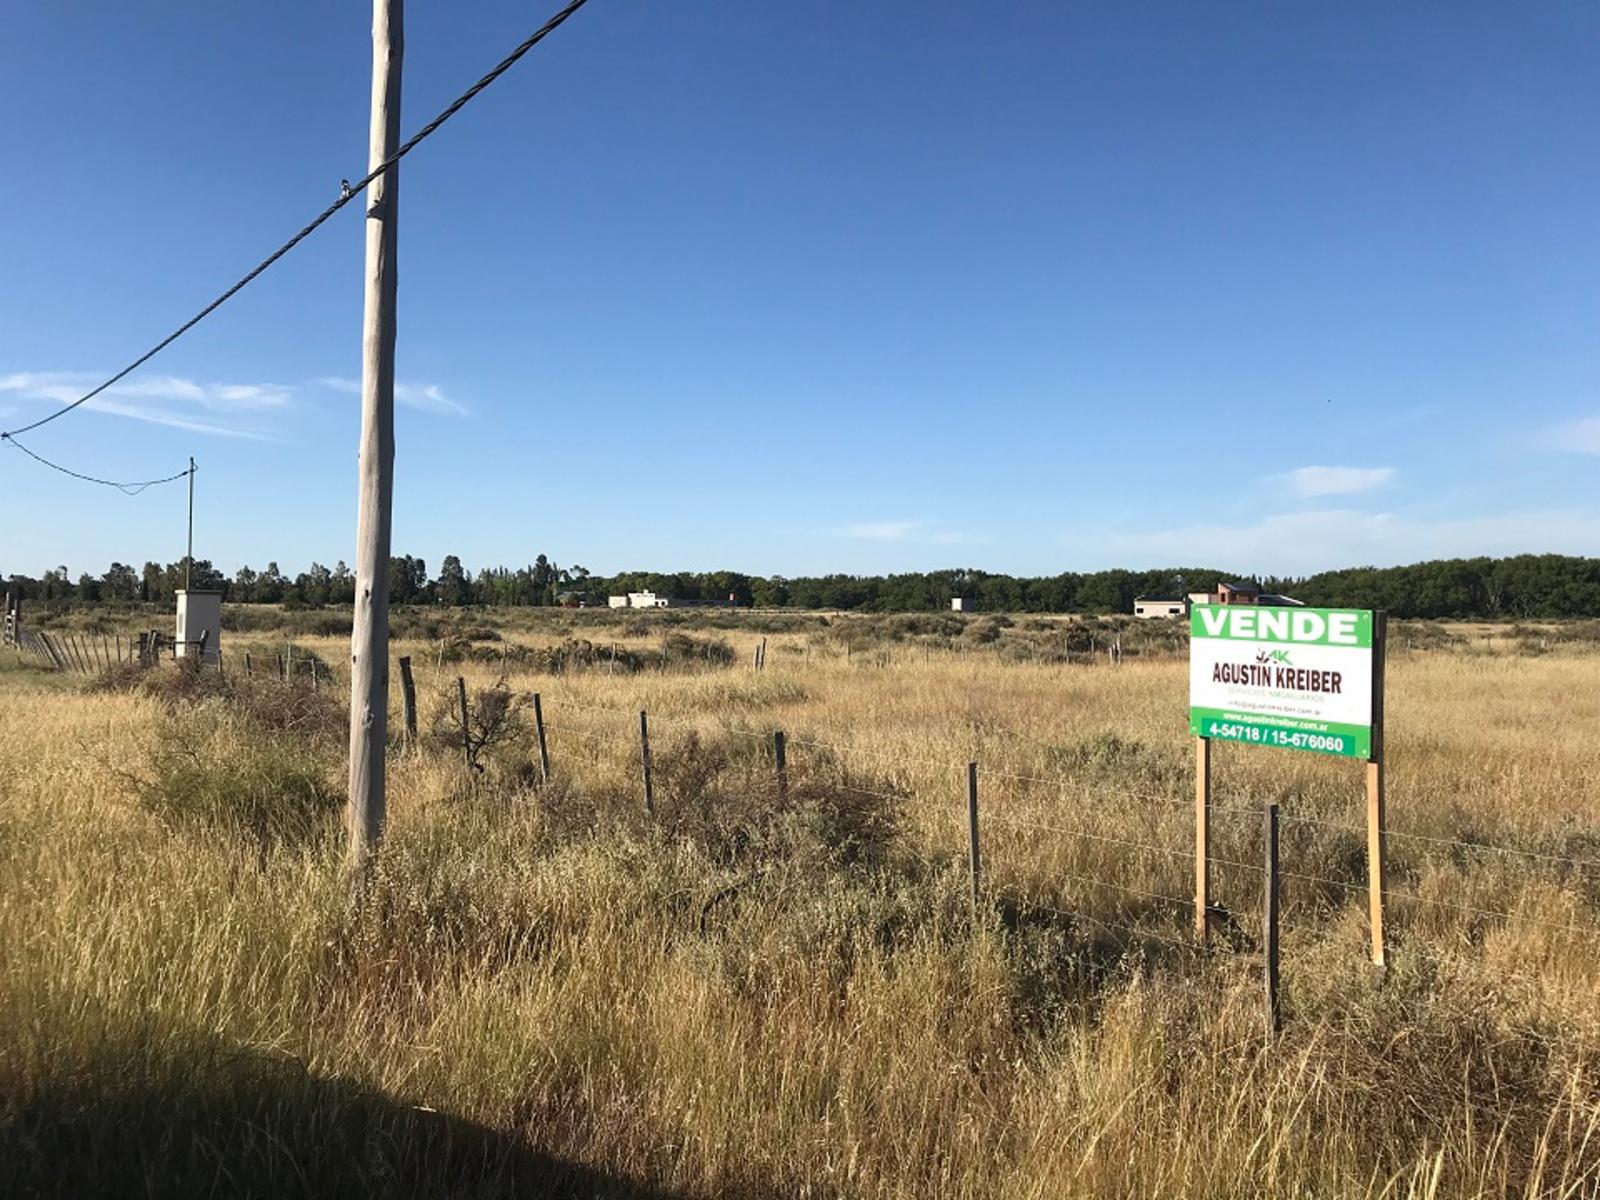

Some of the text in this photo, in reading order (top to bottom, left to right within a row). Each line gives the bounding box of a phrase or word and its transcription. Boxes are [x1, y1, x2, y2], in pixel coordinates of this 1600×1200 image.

[1198, 608, 1358, 644] VENDE
[1212, 662, 1342, 694] AGUSTIN KREIBER
[1209, 724, 1343, 752] 4-54718 / 15-676060
